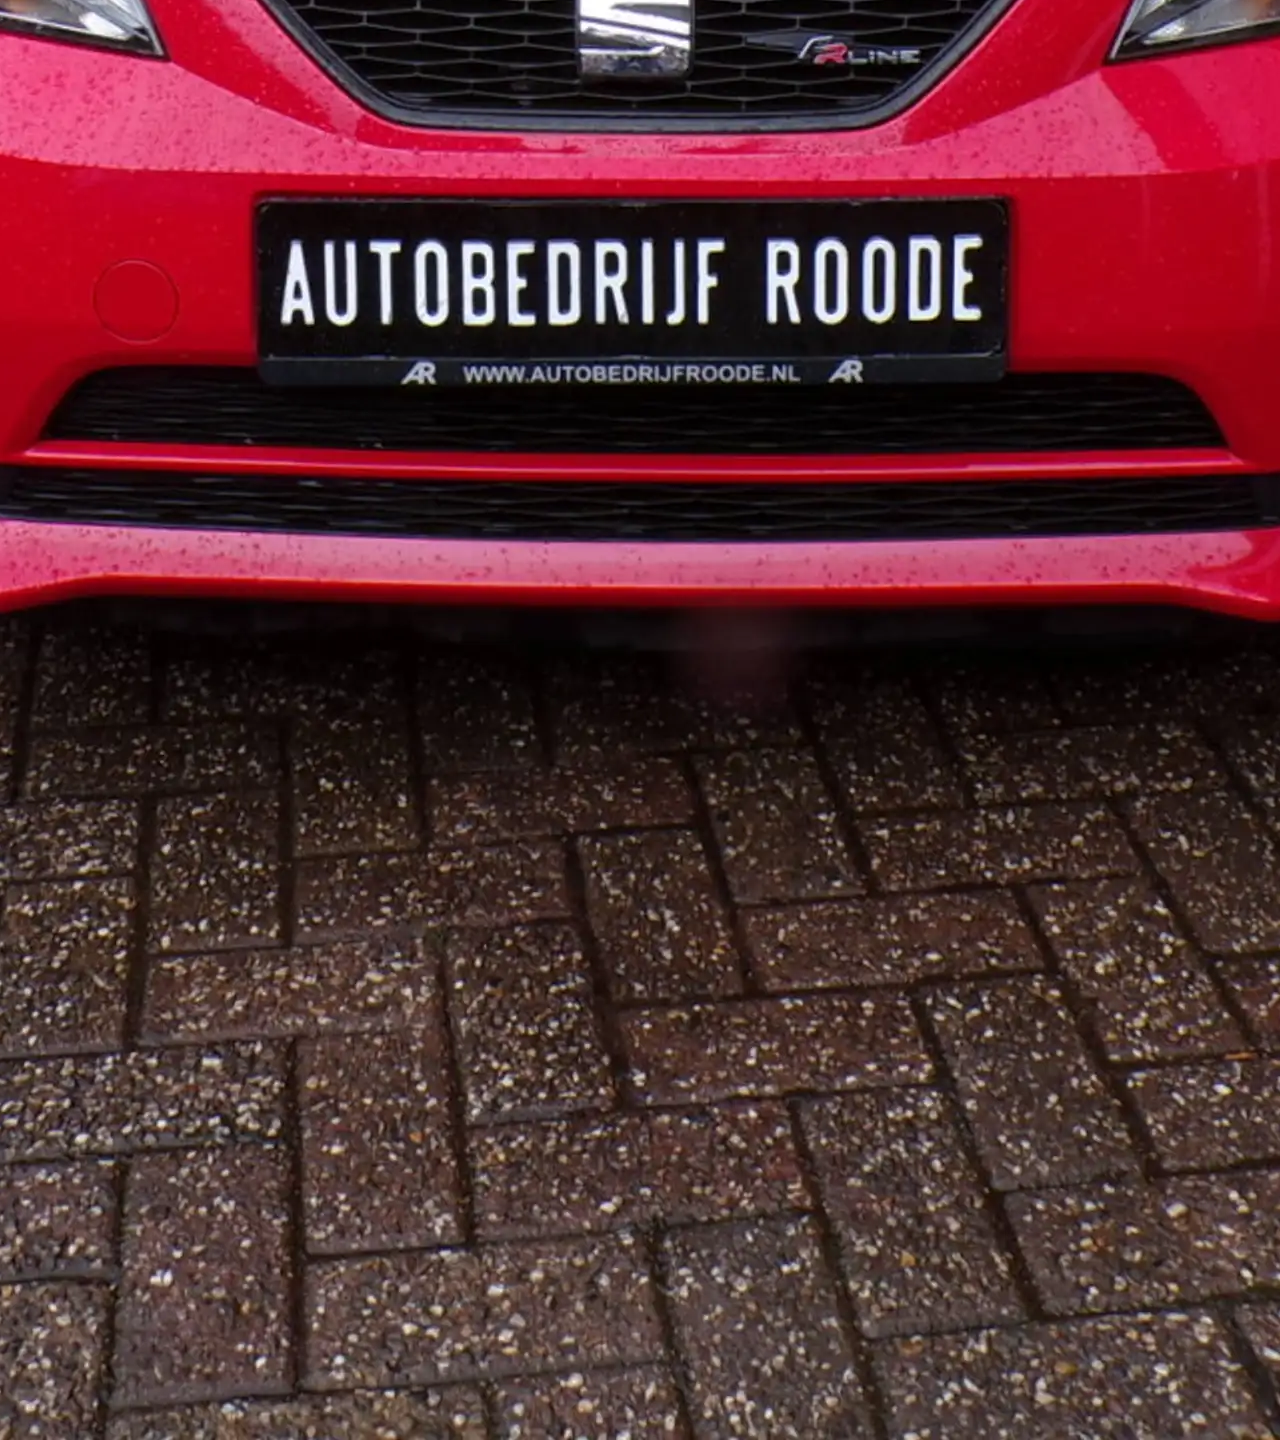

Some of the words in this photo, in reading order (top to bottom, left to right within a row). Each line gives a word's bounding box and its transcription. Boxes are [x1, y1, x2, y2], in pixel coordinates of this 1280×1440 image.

[280, 240, 725, 327] AUTOBEDRIJF
[766, 236, 983, 325] ROODE
[463, 365, 801, 384] WWW.AUTOBEDRIJFROODE.NL
